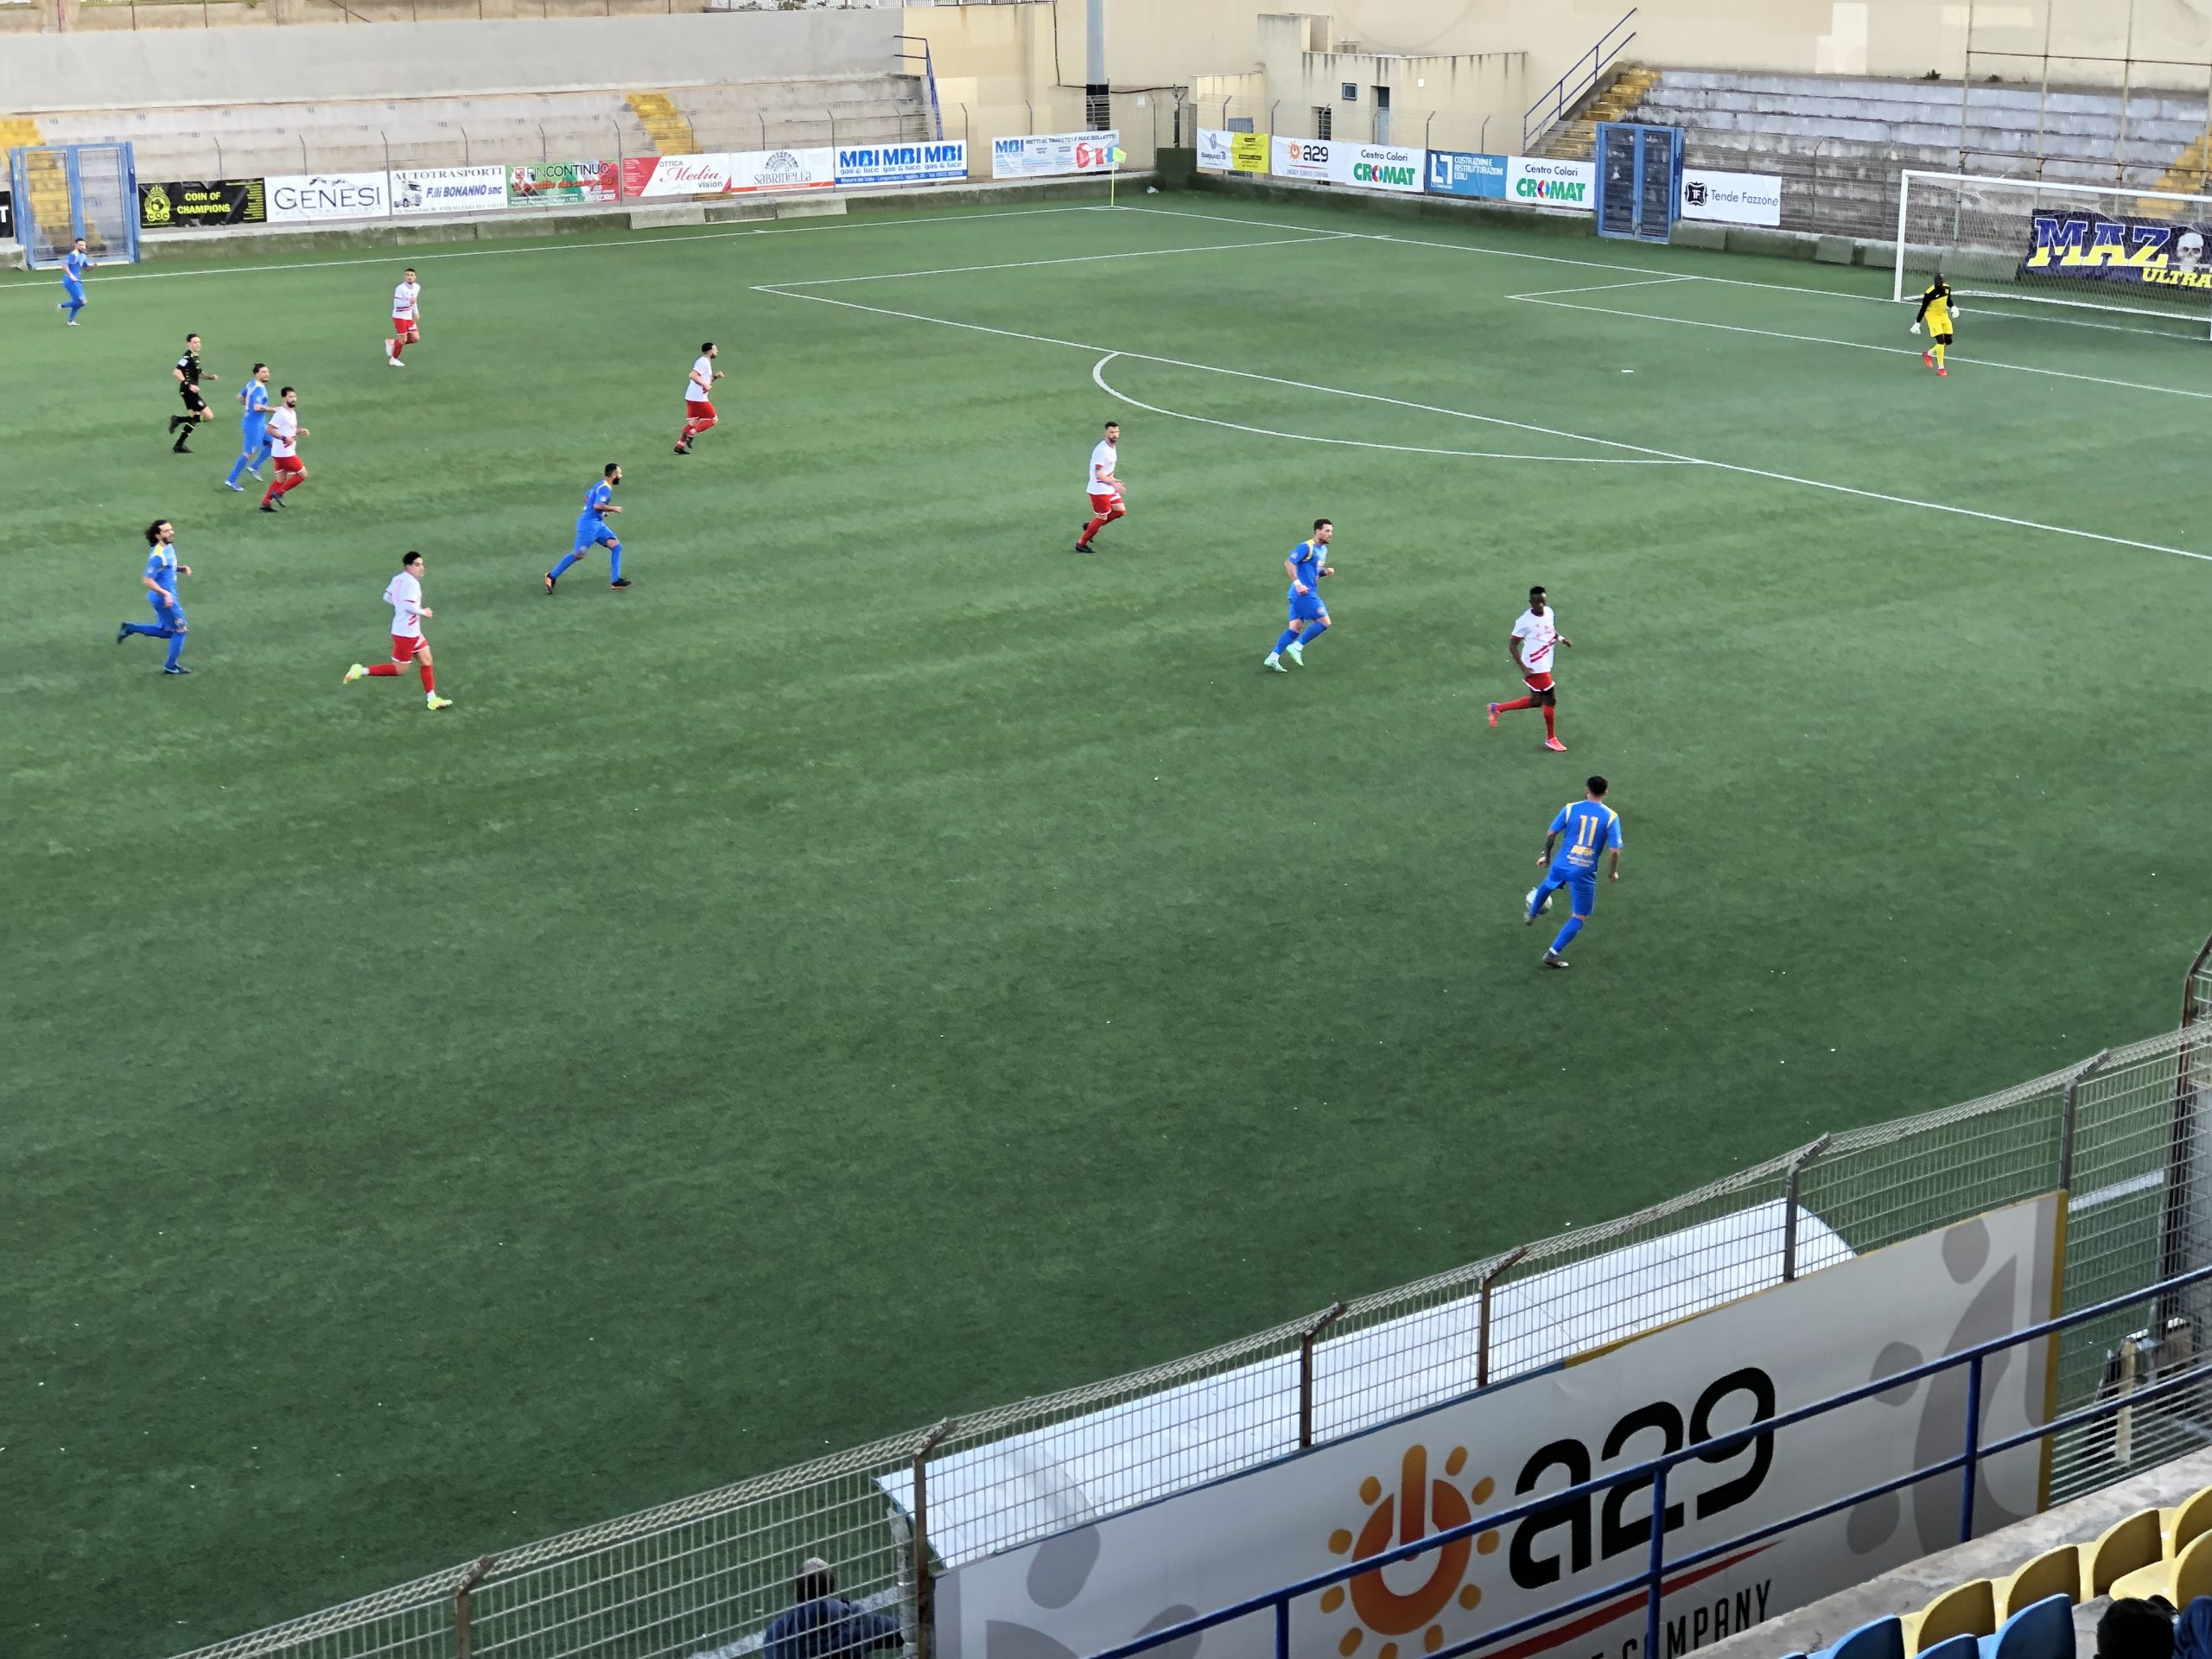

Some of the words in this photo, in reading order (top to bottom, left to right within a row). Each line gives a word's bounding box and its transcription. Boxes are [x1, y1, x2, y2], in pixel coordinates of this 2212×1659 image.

[995, 139, 1024, 153] MBI
[1303, 145, 1329, 162] a29
[840, 149, 880, 168] MBI
[883, 147, 921, 165] MBI
[925, 144, 963, 162] MBI
[1361, 149, 1384, 160] Centro
[1386, 151, 1408, 162] Colori
[393, 167, 503, 181] AUTOTRASPORTI
[526, 162, 610, 179] FINCONTINUO
[660, 164, 719, 182] Media
[1353, 162, 1415, 185] CROMAT
[1525, 163, 1552, 175] Centro
[1554, 166, 1579, 176] Colori
[184, 192, 207, 201] COIN
[209, 191, 221, 200] OF
[274, 186, 381, 210] GENESI
[426, 187, 442, 198] F.lli
[443, 184, 486, 198] BONANNO
[488, 186, 503, 195] snc
[1516, 177, 1586, 201] CROMAT
[1711, 189, 1738, 202] Tende
[1742, 192, 1779, 207] Fazzone
[177, 203, 231, 214] CHAMPIONS
[2027, 218, 2171, 268] MAZ
[2142, 267, 2212, 289] ULTRA
[1580, 815, 1599, 847] 11
[1510, 1367, 1776, 1590] a29
